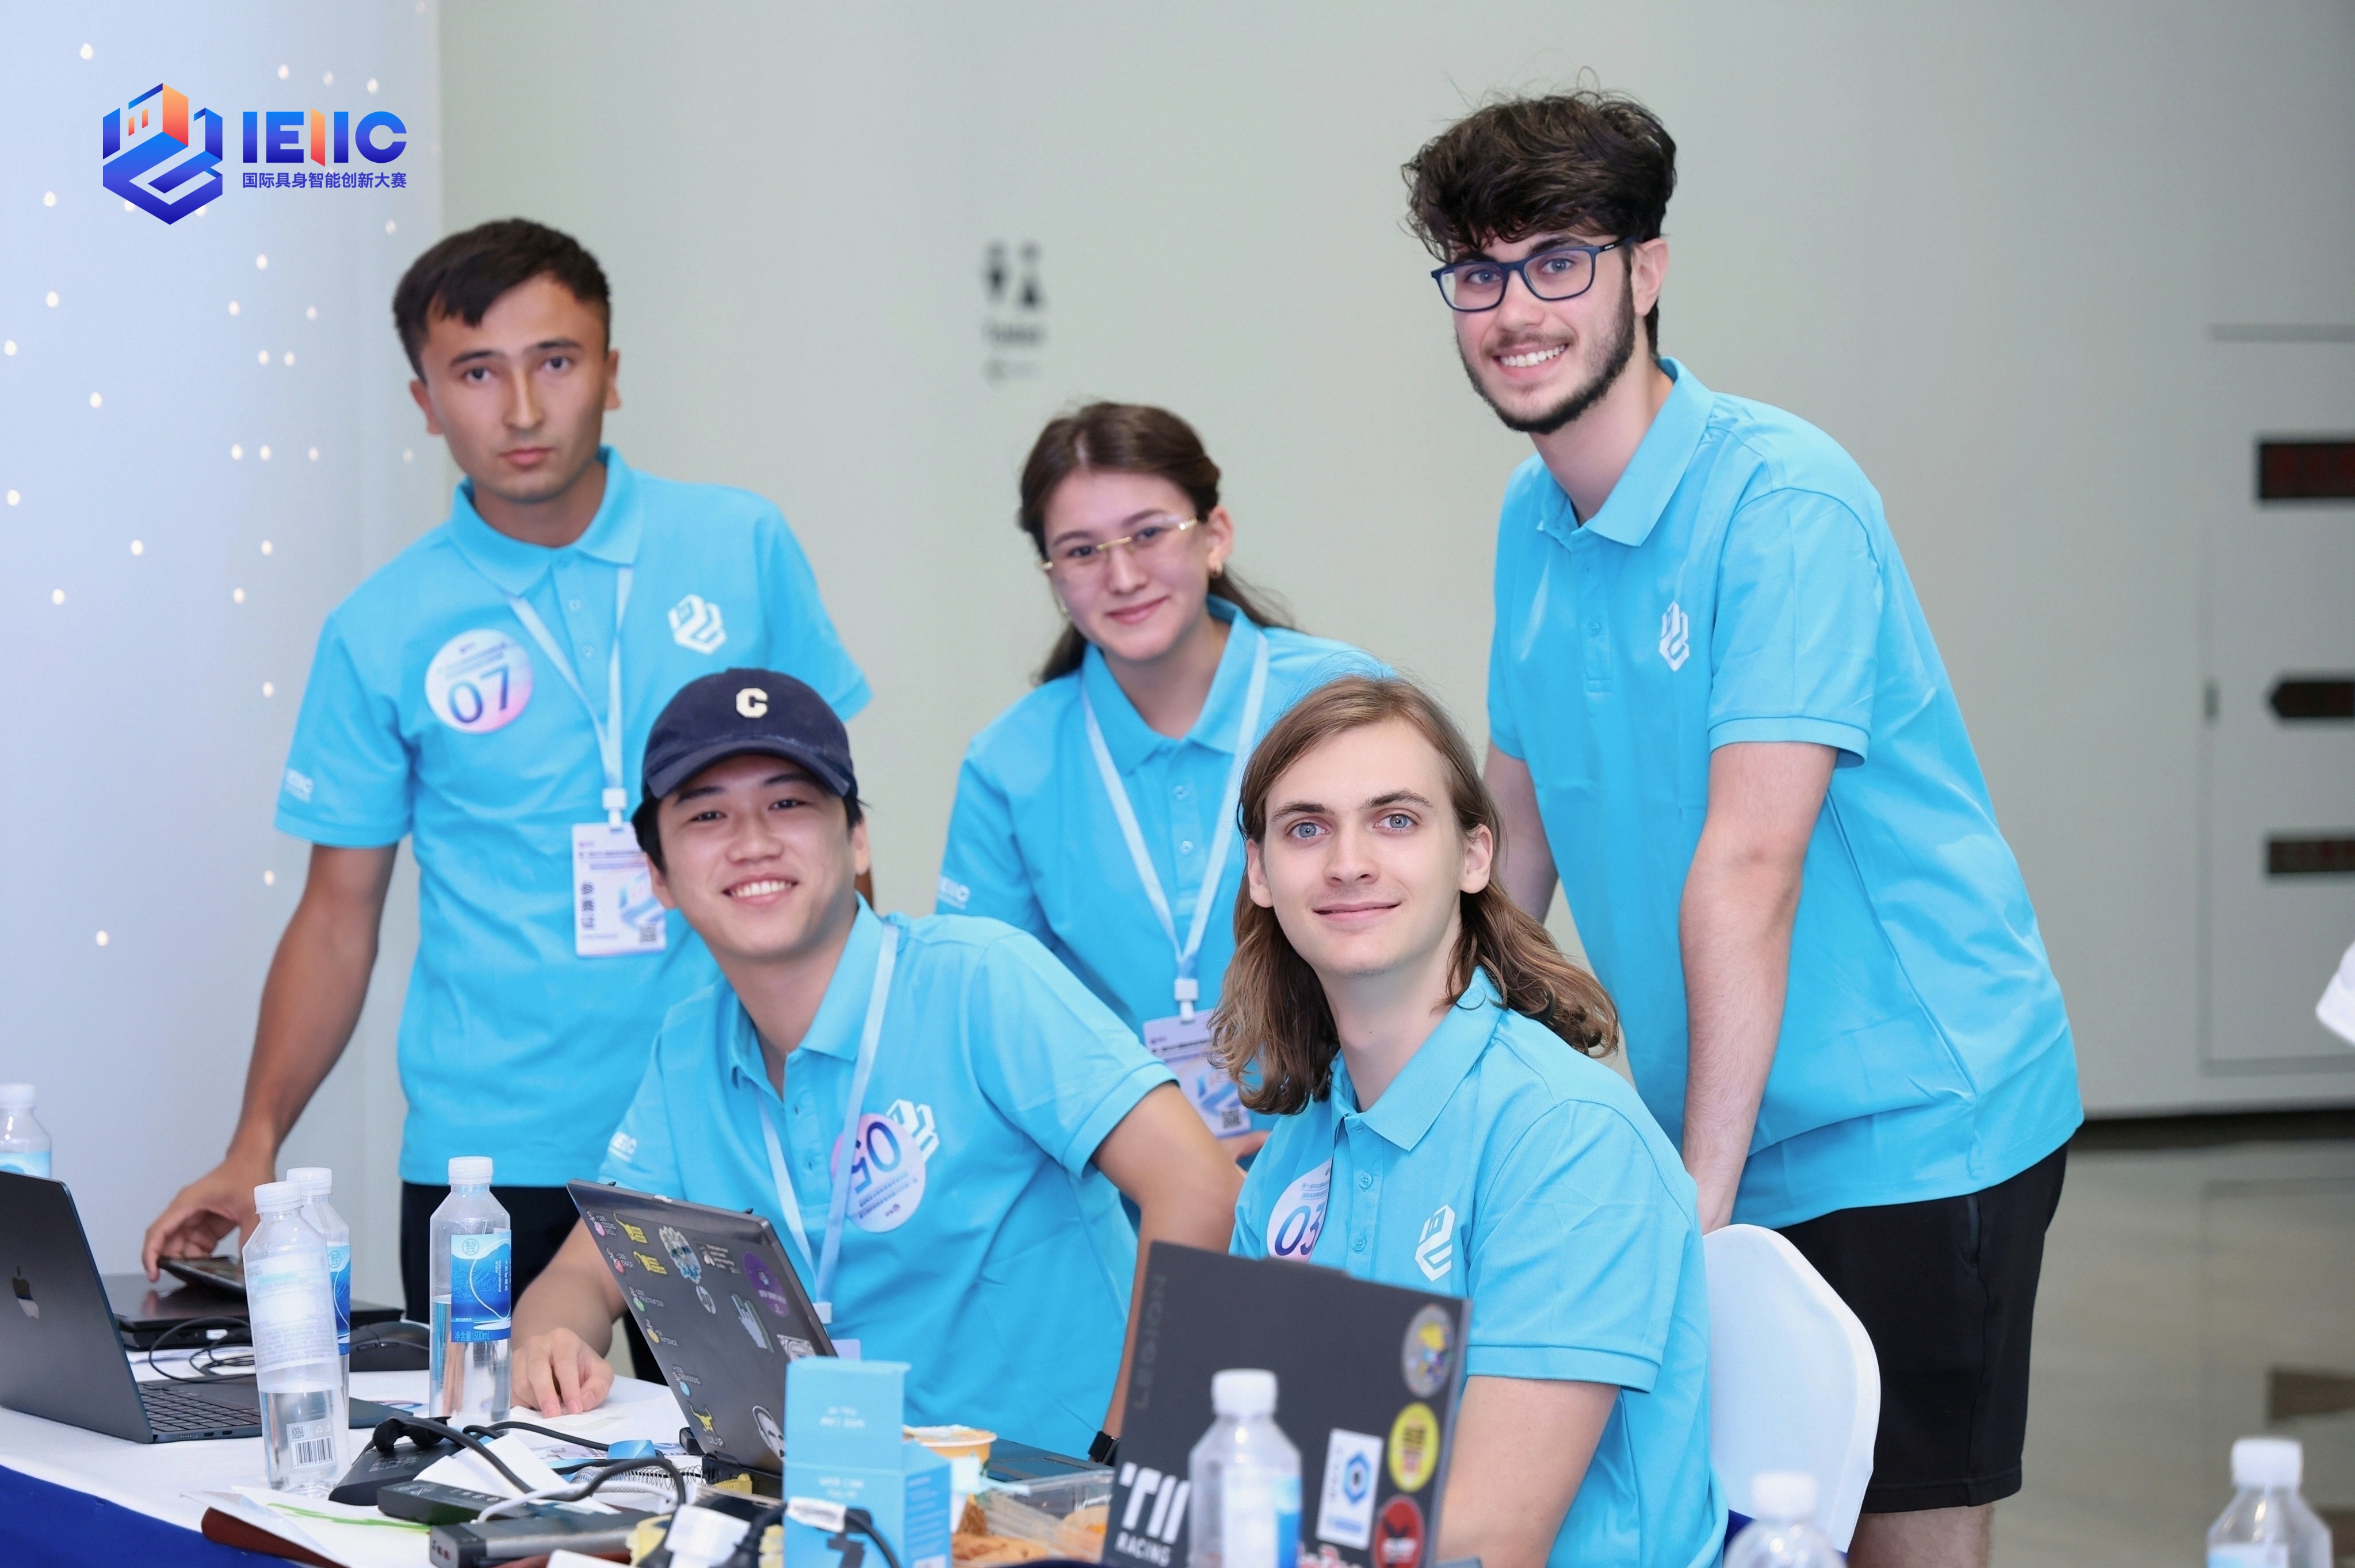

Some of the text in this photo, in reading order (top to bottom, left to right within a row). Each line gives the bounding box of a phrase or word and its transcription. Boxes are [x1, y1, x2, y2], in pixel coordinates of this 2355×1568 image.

[448, 664, 510, 724] 07
[736, 687, 769, 719] C
[1114, 1531, 1171, 1567] RACING
